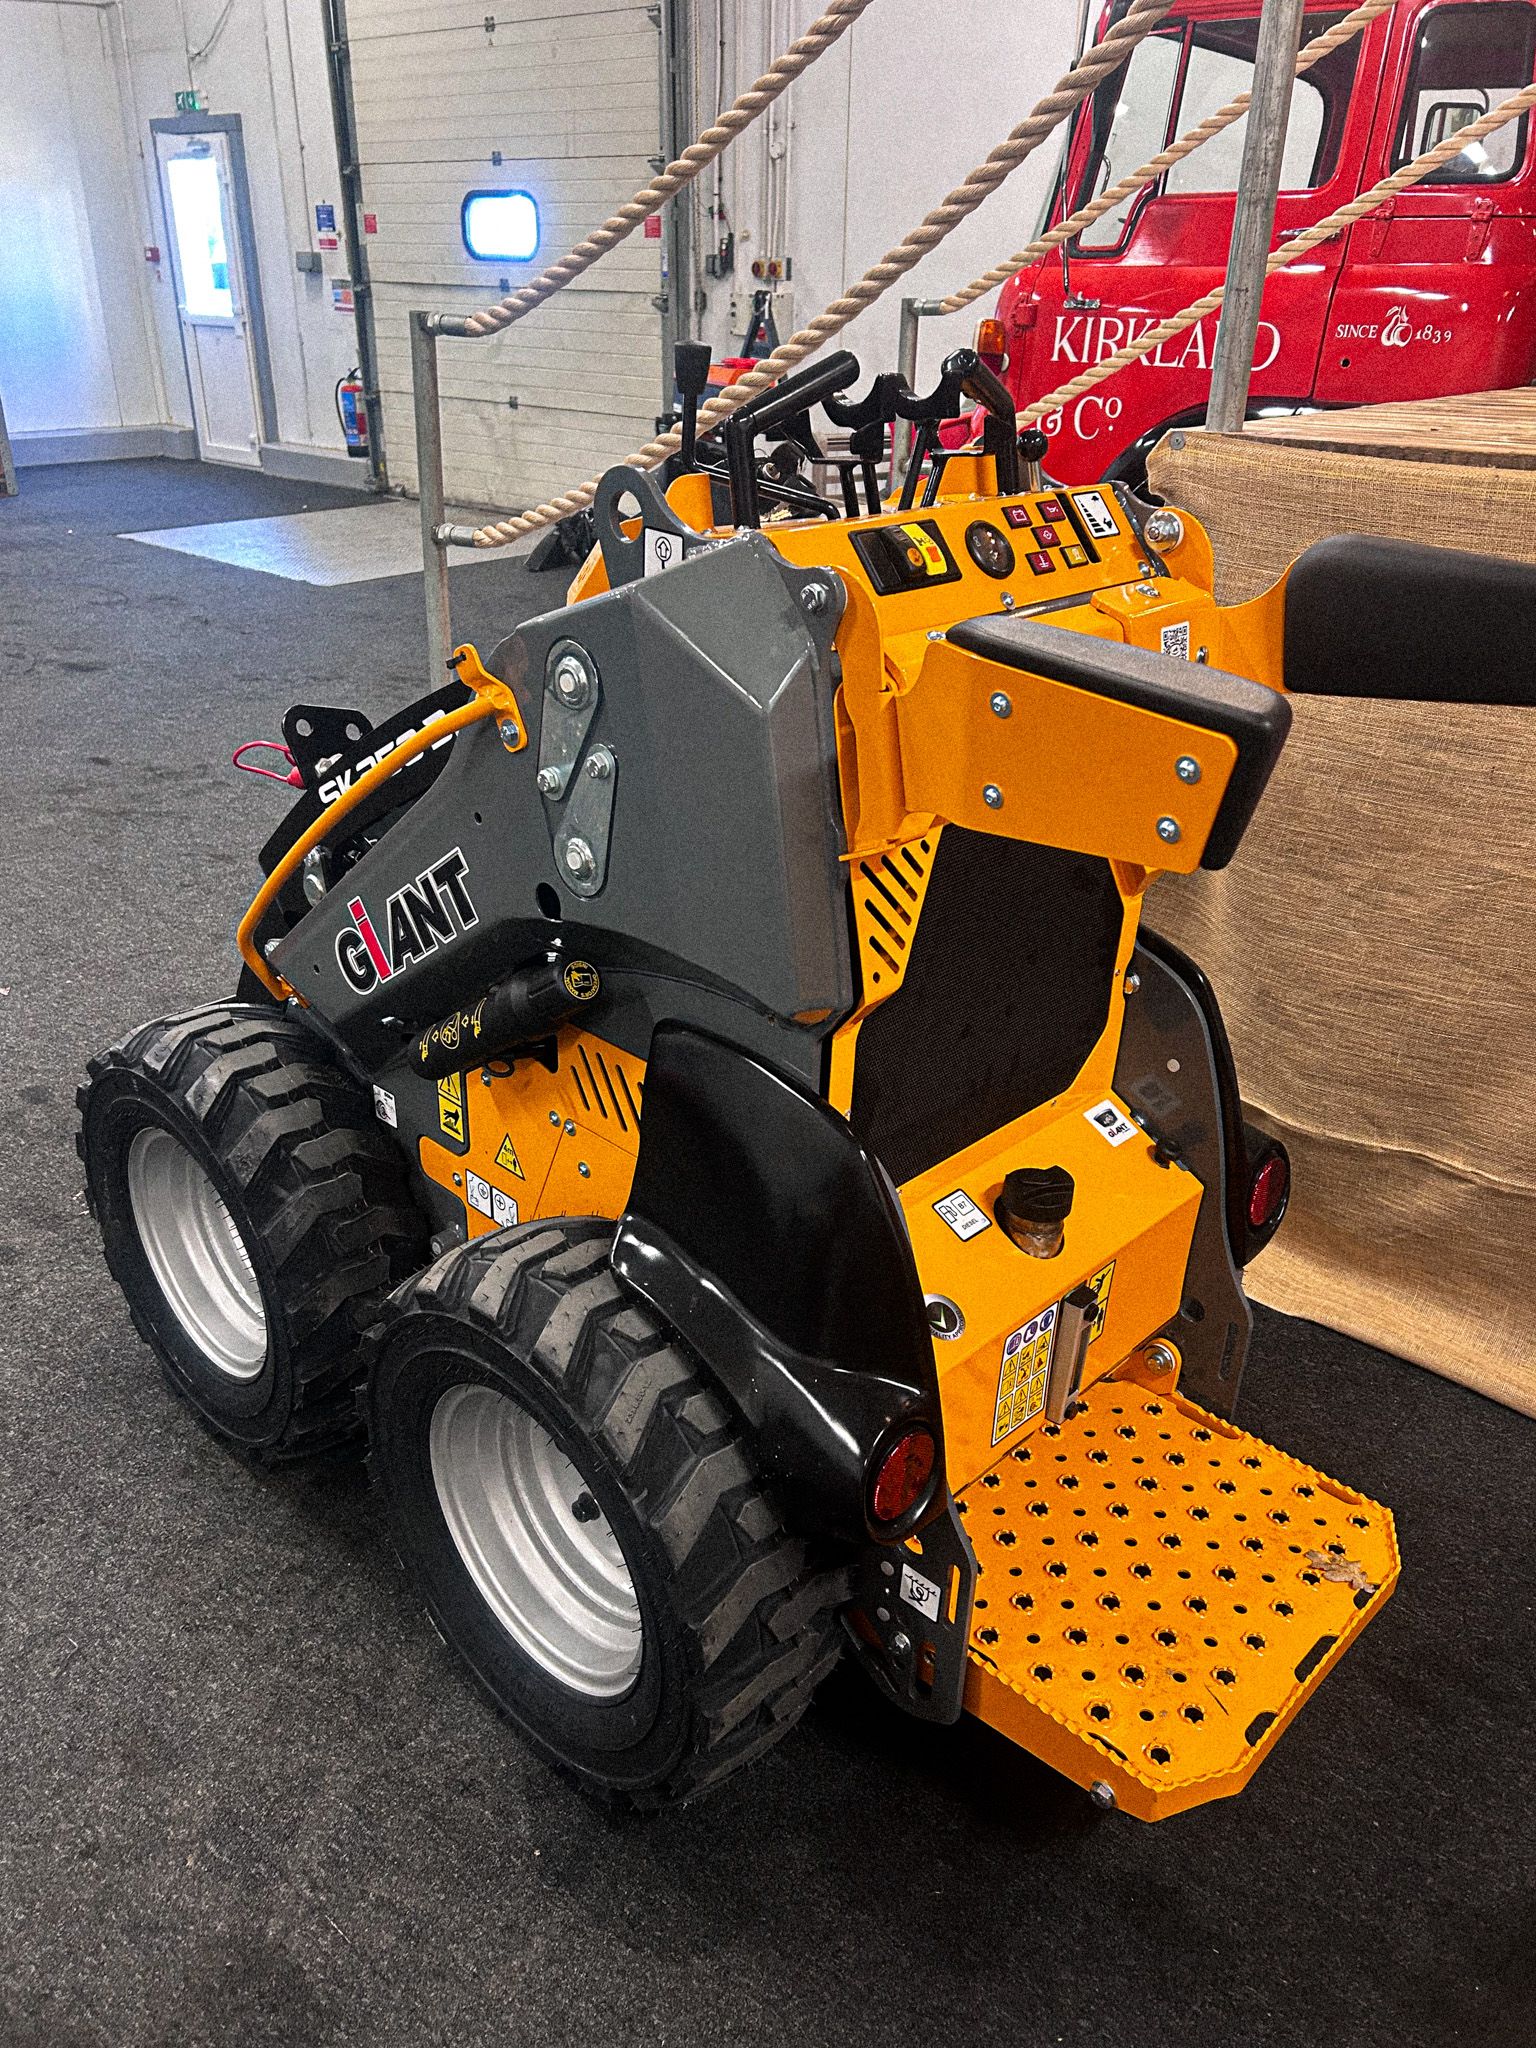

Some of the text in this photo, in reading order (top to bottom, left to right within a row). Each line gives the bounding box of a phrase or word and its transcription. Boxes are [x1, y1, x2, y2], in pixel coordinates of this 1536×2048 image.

[1051, 316, 1281, 372] KIRKLAD
[1335, 324, 1452, 344] SINCE 1839
